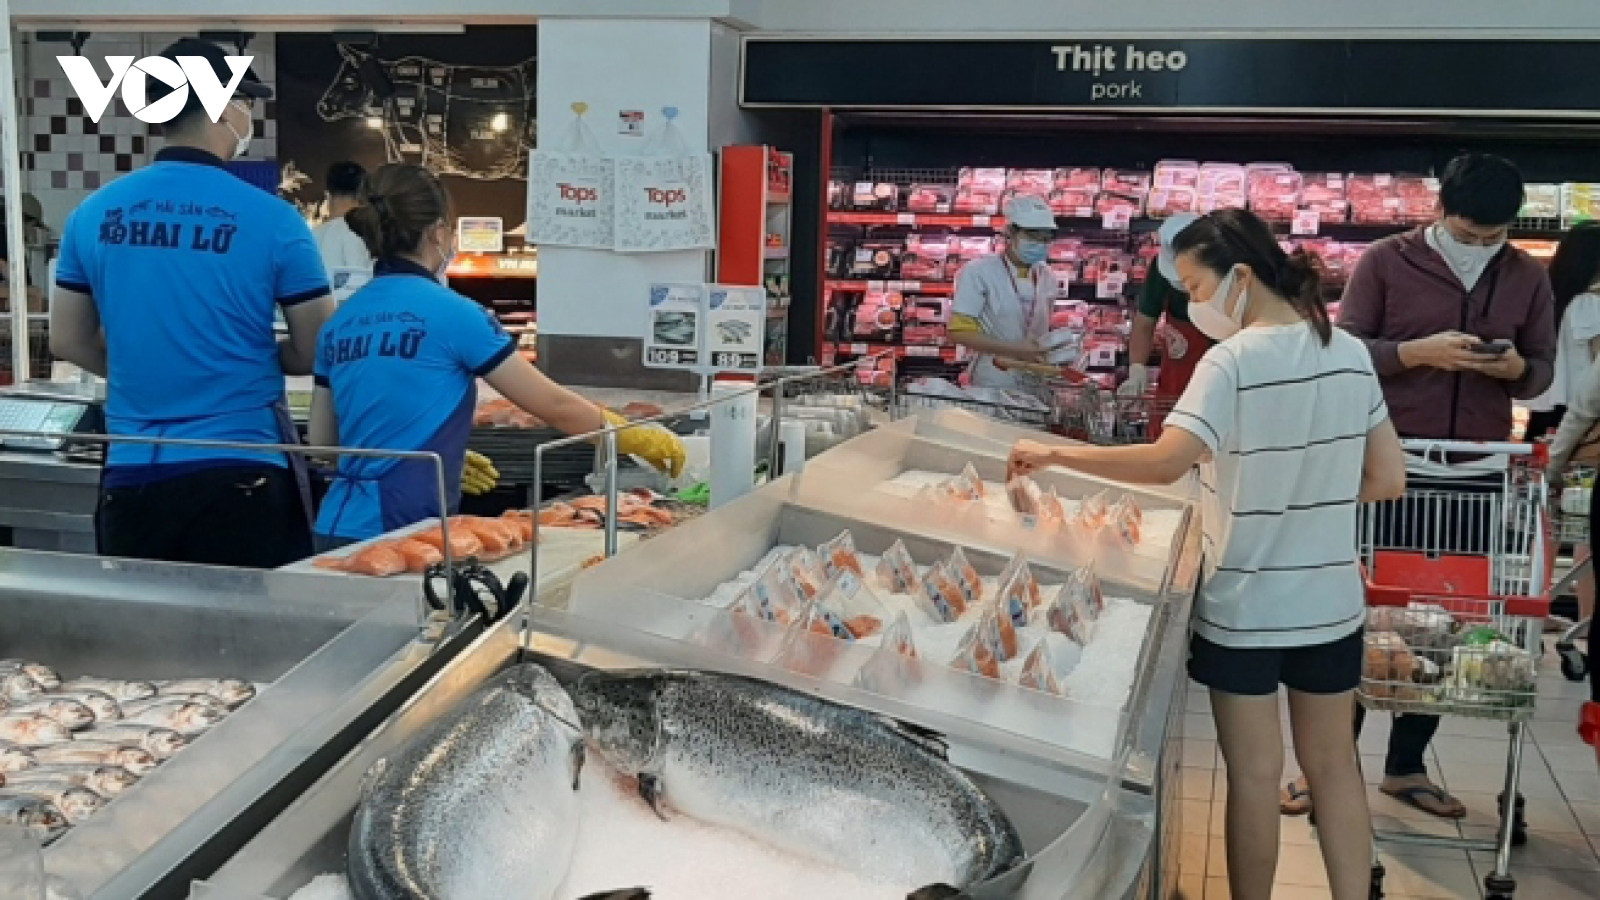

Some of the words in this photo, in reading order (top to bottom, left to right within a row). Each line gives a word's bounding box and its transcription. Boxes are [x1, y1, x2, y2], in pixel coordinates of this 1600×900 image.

[1051, 44, 1117, 76] Thịt
[1126, 44, 1187, 71] heo
[1090, 80, 1142, 100] pork
[556, 182, 598, 205] Tops
[644, 187, 686, 207] Tops
[129, 220, 181, 249] HAI
[337, 332, 373, 364] HAI
